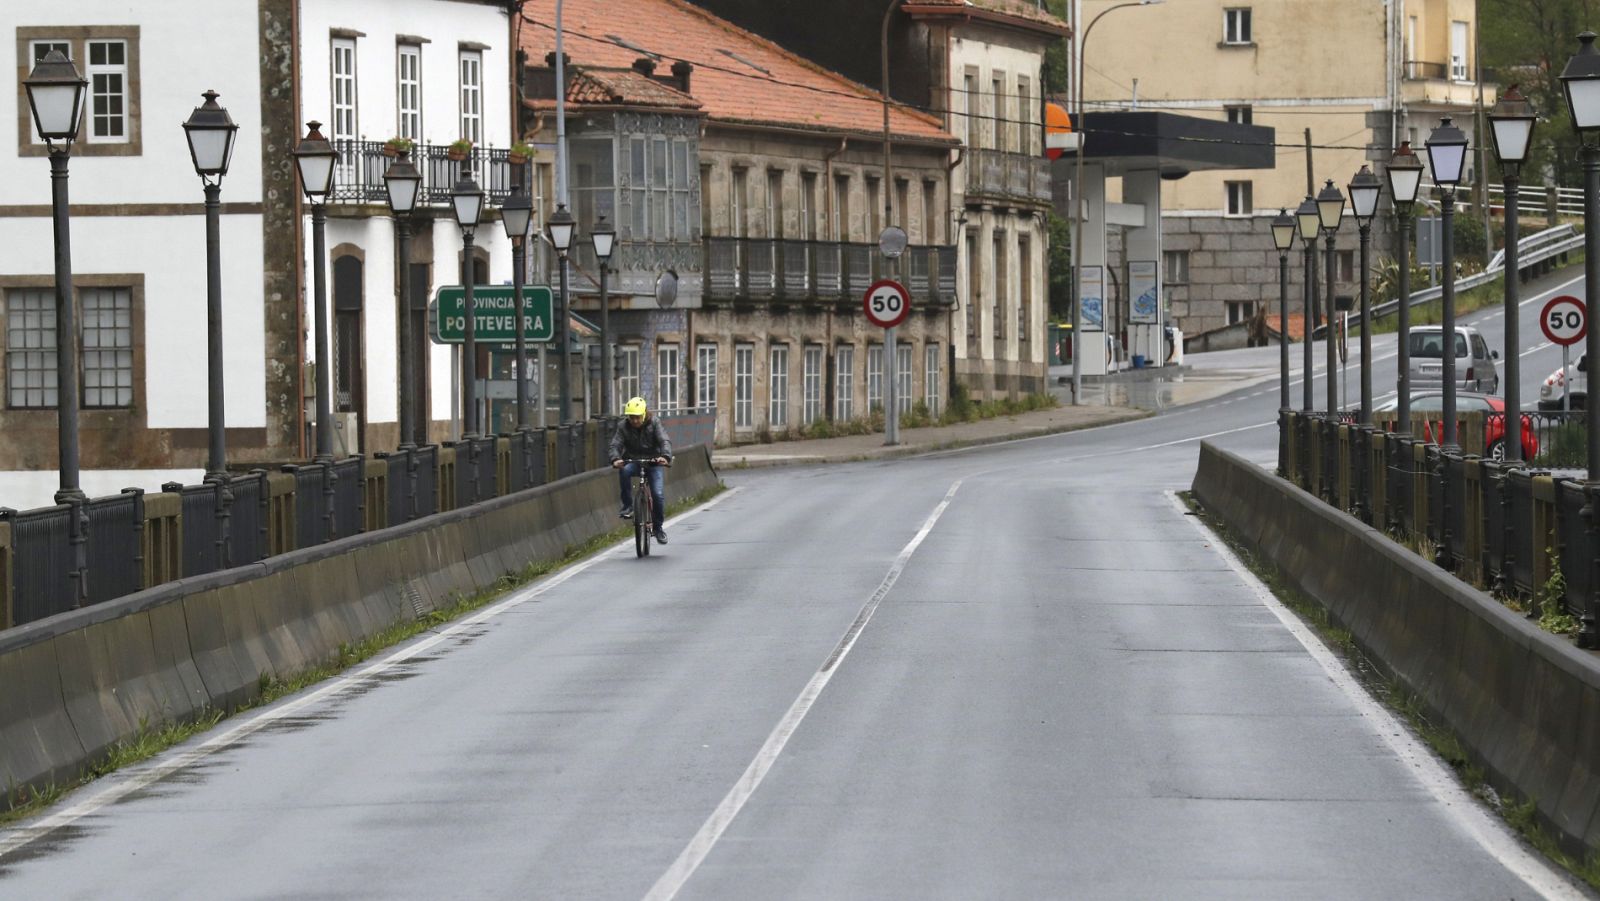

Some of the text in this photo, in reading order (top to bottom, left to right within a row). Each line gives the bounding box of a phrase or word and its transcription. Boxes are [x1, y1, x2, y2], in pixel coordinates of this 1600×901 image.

[456, 297, 515, 309] POVINCIA
[873, 295, 901, 313] 50
[446, 315, 544, 331] POTEVERA
[1550, 311, 1581, 330] 50
